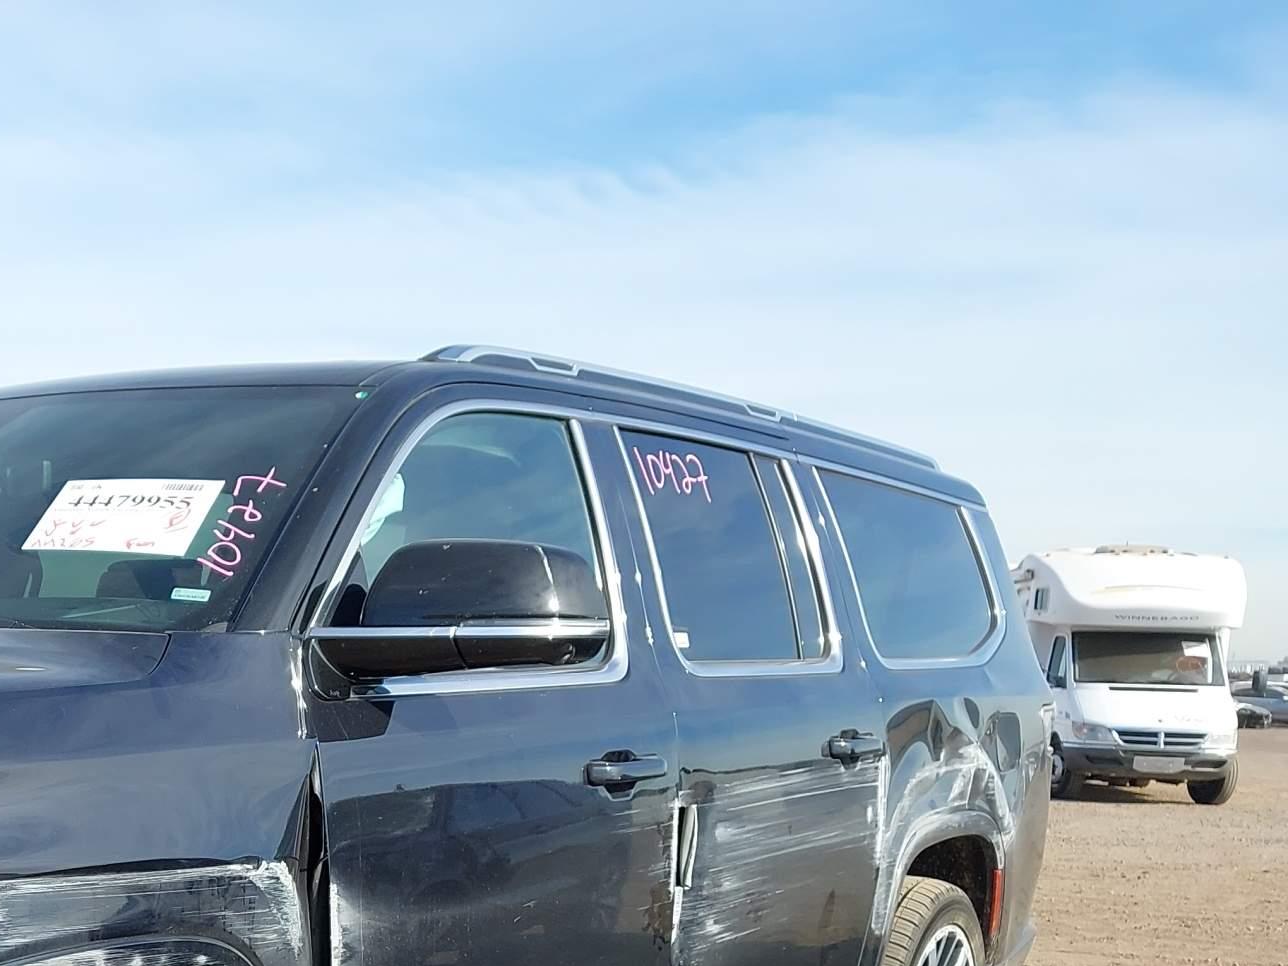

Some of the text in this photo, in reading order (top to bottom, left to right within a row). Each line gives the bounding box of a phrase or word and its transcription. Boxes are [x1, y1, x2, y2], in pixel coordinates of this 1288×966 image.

[68, 494, 195, 510] 44479955
[633, 446, 712, 504] 10427
[197, 466, 287, 577] 10427
